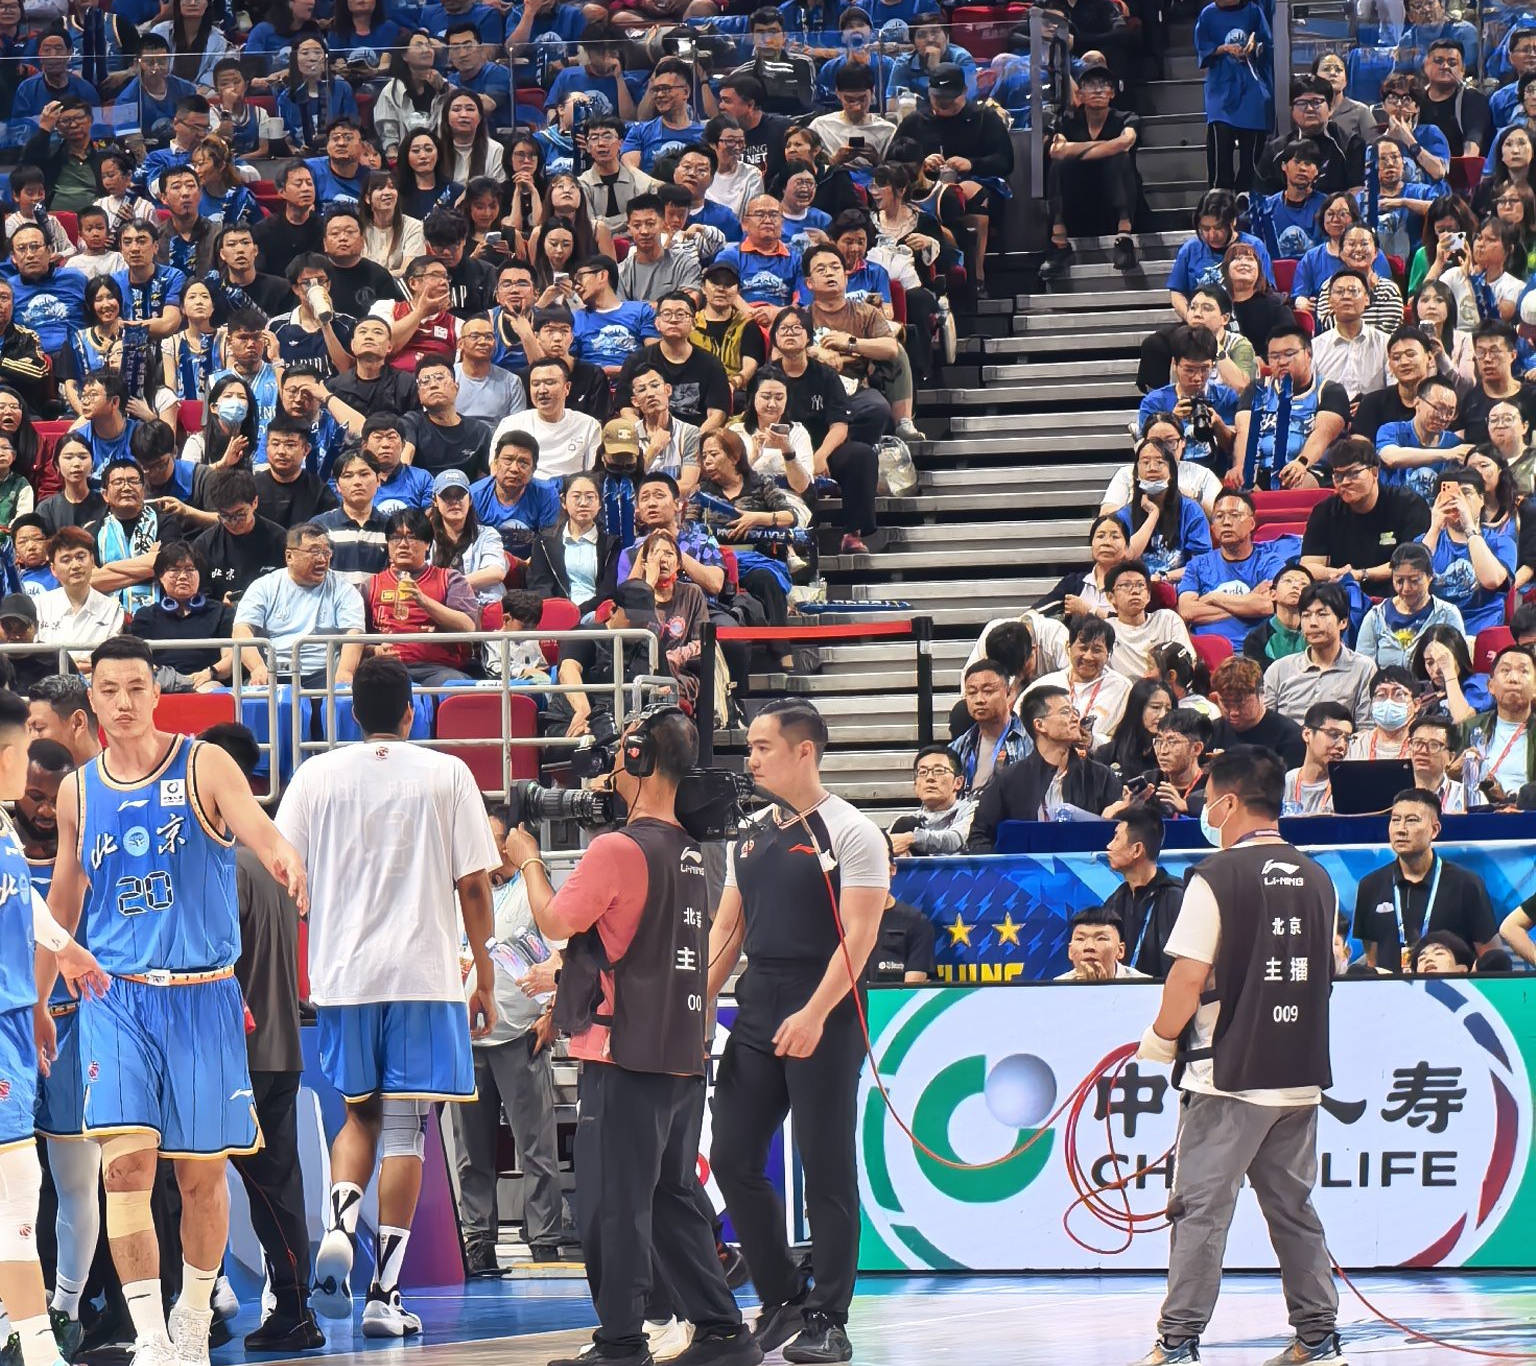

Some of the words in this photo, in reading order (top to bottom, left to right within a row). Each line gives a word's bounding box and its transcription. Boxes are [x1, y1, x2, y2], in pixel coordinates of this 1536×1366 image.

[211, 567, 235, 580] 北京
[115, 870, 174, 917] 20
[1272, 916, 1302, 936] 北京
[1264, 956, 1308, 982] 主播
[1273, 1004, 1299, 1023] 009
[1321, 1150, 1458, 1188] LIFE
